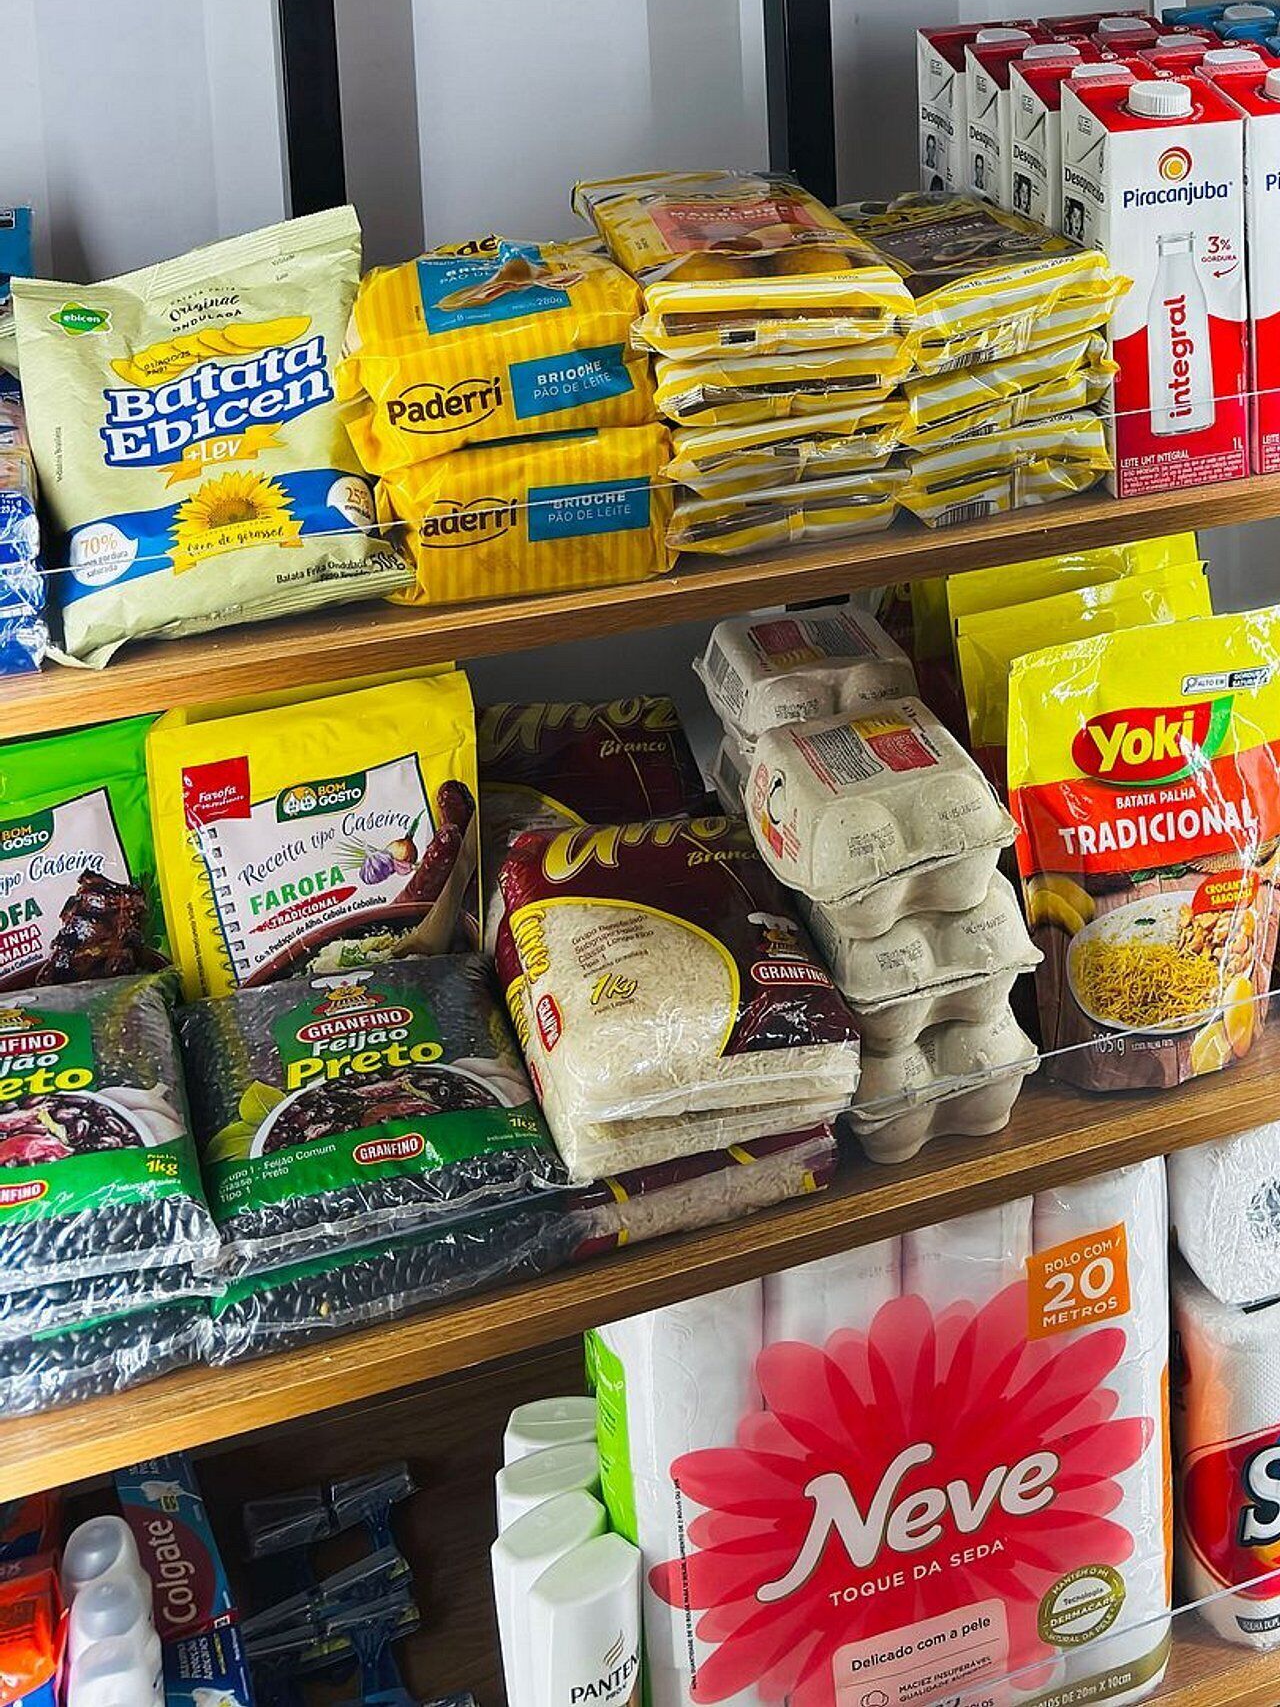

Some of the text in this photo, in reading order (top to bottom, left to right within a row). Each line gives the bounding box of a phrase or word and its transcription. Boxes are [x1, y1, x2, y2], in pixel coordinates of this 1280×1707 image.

[1123, 180, 1229, 210] Piracanjuba
[1207, 235, 1232, 255] 3%
[169, 294, 241, 323] Original
[172, 308, 243, 333] ONDULADA
[1163, 294, 1190, 419] integral
[107, 336, 324, 424] Batata
[533, 372, 612, 401] PÃO DE LEITE
[536, 358, 602, 386] BRIOCHE
[107, 368, 331, 463] Ebicen
[548, 503, 632, 524] PÃO DE LEITE
[551, 491, 627, 512] BRIOCHE
[80, 534, 118, 560] 70%
[600, 737, 668, 759] Branco
[1089, 710, 1198, 772] Yoki
[198, 785, 238, 802] Farofa
[317, 782, 347, 796] BOM
[318, 788, 363, 807] GOSTO
[1115, 786, 1198, 810] BATATA PALHA
[2, 825, 32, 841] BOM
[3, 830, 49, 851] GOSTO
[1059, 797, 1258, 857] TRADICIONAL
[238, 811, 412, 887] Receita tipo Caseira
[29, 850, 105, 882] Caseira
[250, 864, 346, 916] FAROFA
[268, 896, 339, 930] TRADICIONAL
[590, 971, 639, 1005] 1kg
[758, 965, 830, 983] GRANFINO
[307, 1010, 404, 1040] GRANFINO
[311, 1026, 410, 1058] Feijão
[286, 1039, 444, 1091] Preto
[359, 1137, 419, 1161] GRANFINO
[146, 1159, 178, 1176] 1kg
[1045, 1241, 1116, 1276] ROLO COM
[1043, 1256, 1116, 1314] 20
[1042, 1296, 1119, 1329] METROS
[756, 1442, 1060, 1603] Neve
[157, 1519, 198, 1626] Colgate
[829, 1541, 1004, 1607] TOQUE DA SEDA
[1063, 1587, 1104, 1606] Tecnologia
[851, 1616, 992, 1673] Delicado com a pele
[899, 1676, 932, 1695] MACIEZ
